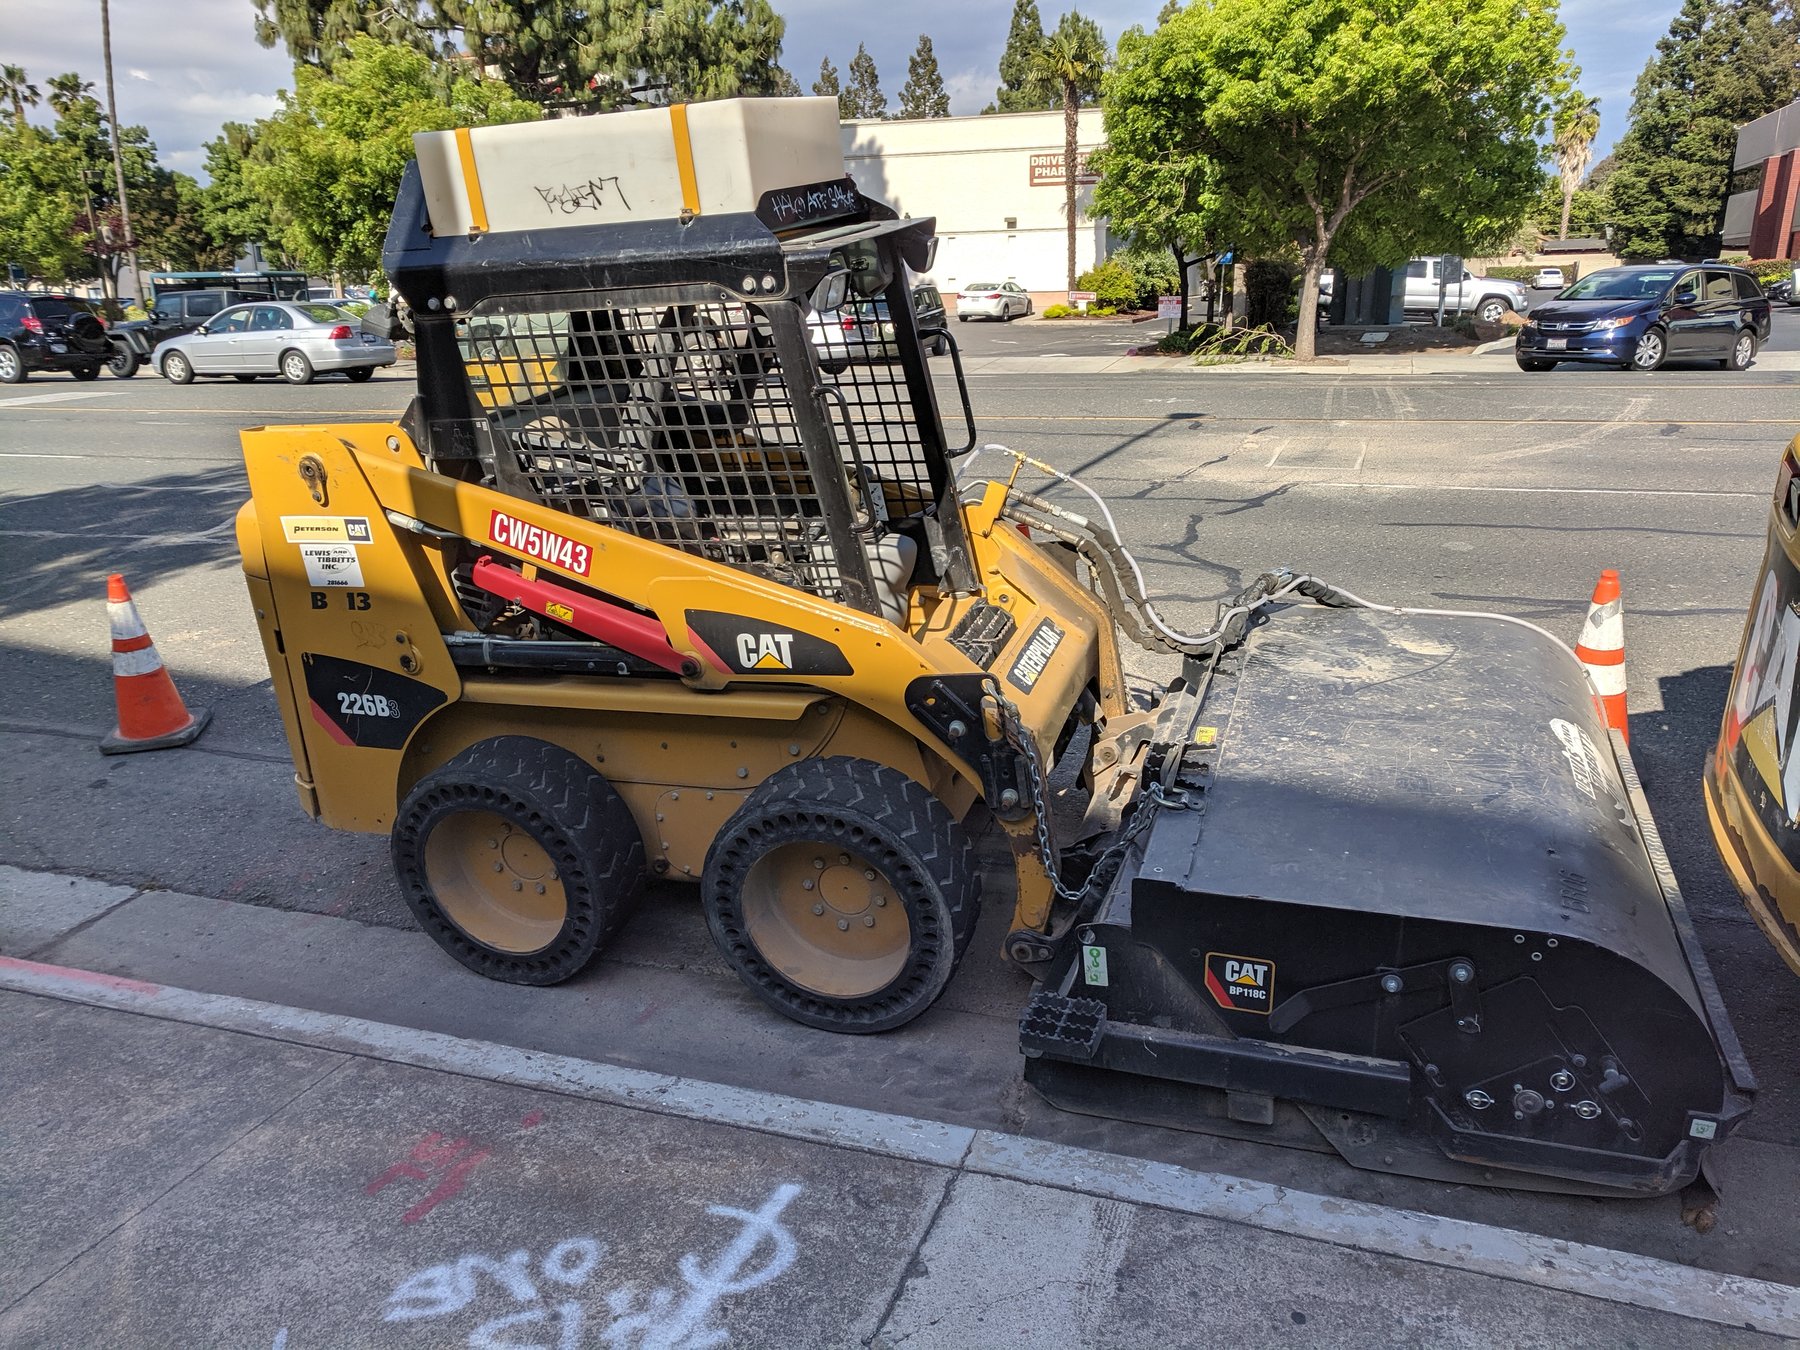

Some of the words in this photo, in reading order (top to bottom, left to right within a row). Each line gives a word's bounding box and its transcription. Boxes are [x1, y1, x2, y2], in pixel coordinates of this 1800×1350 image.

[1031, 155, 1066, 166] DRIVE
[294, 526, 339, 534] PETERSON
[347, 524, 367, 537] CAT
[494, 513, 588, 574] CW5W43
[311, 592, 328, 610] B
[346, 592, 372, 611] 13
[736, 633, 794, 669] CAT
[1013, 625, 1061, 686] CATERPILLAR
[1225, 960, 1268, 987] CAT
[1229, 985, 1266, 1000] BP118C
